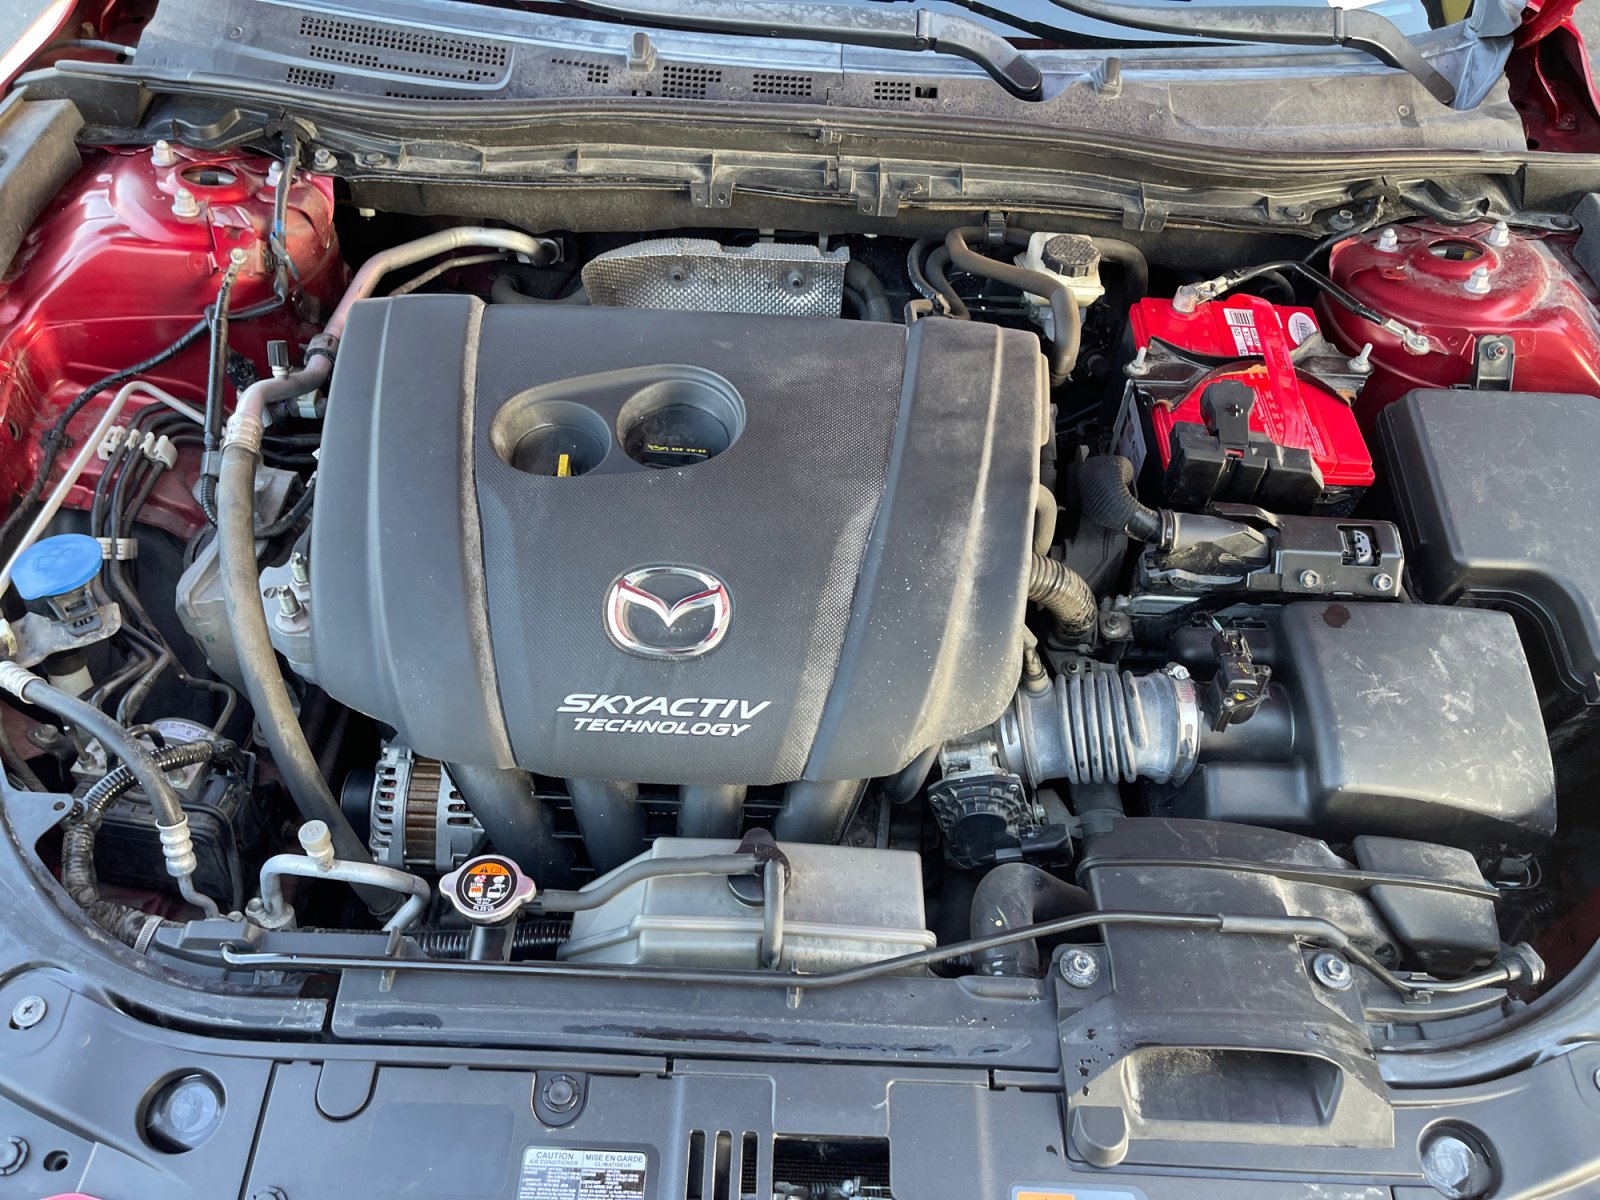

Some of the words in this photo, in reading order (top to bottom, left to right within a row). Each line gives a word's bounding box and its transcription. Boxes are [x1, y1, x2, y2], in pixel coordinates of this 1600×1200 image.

[556, 693, 772, 719] SKYACTIV
[573, 717, 752, 737] TECHNOLOGY
[536, 1151, 574, 1160] CAUTION
[585, 1154, 604, 1162] MISE
[616, 1155, 643, 1163] GARDE
